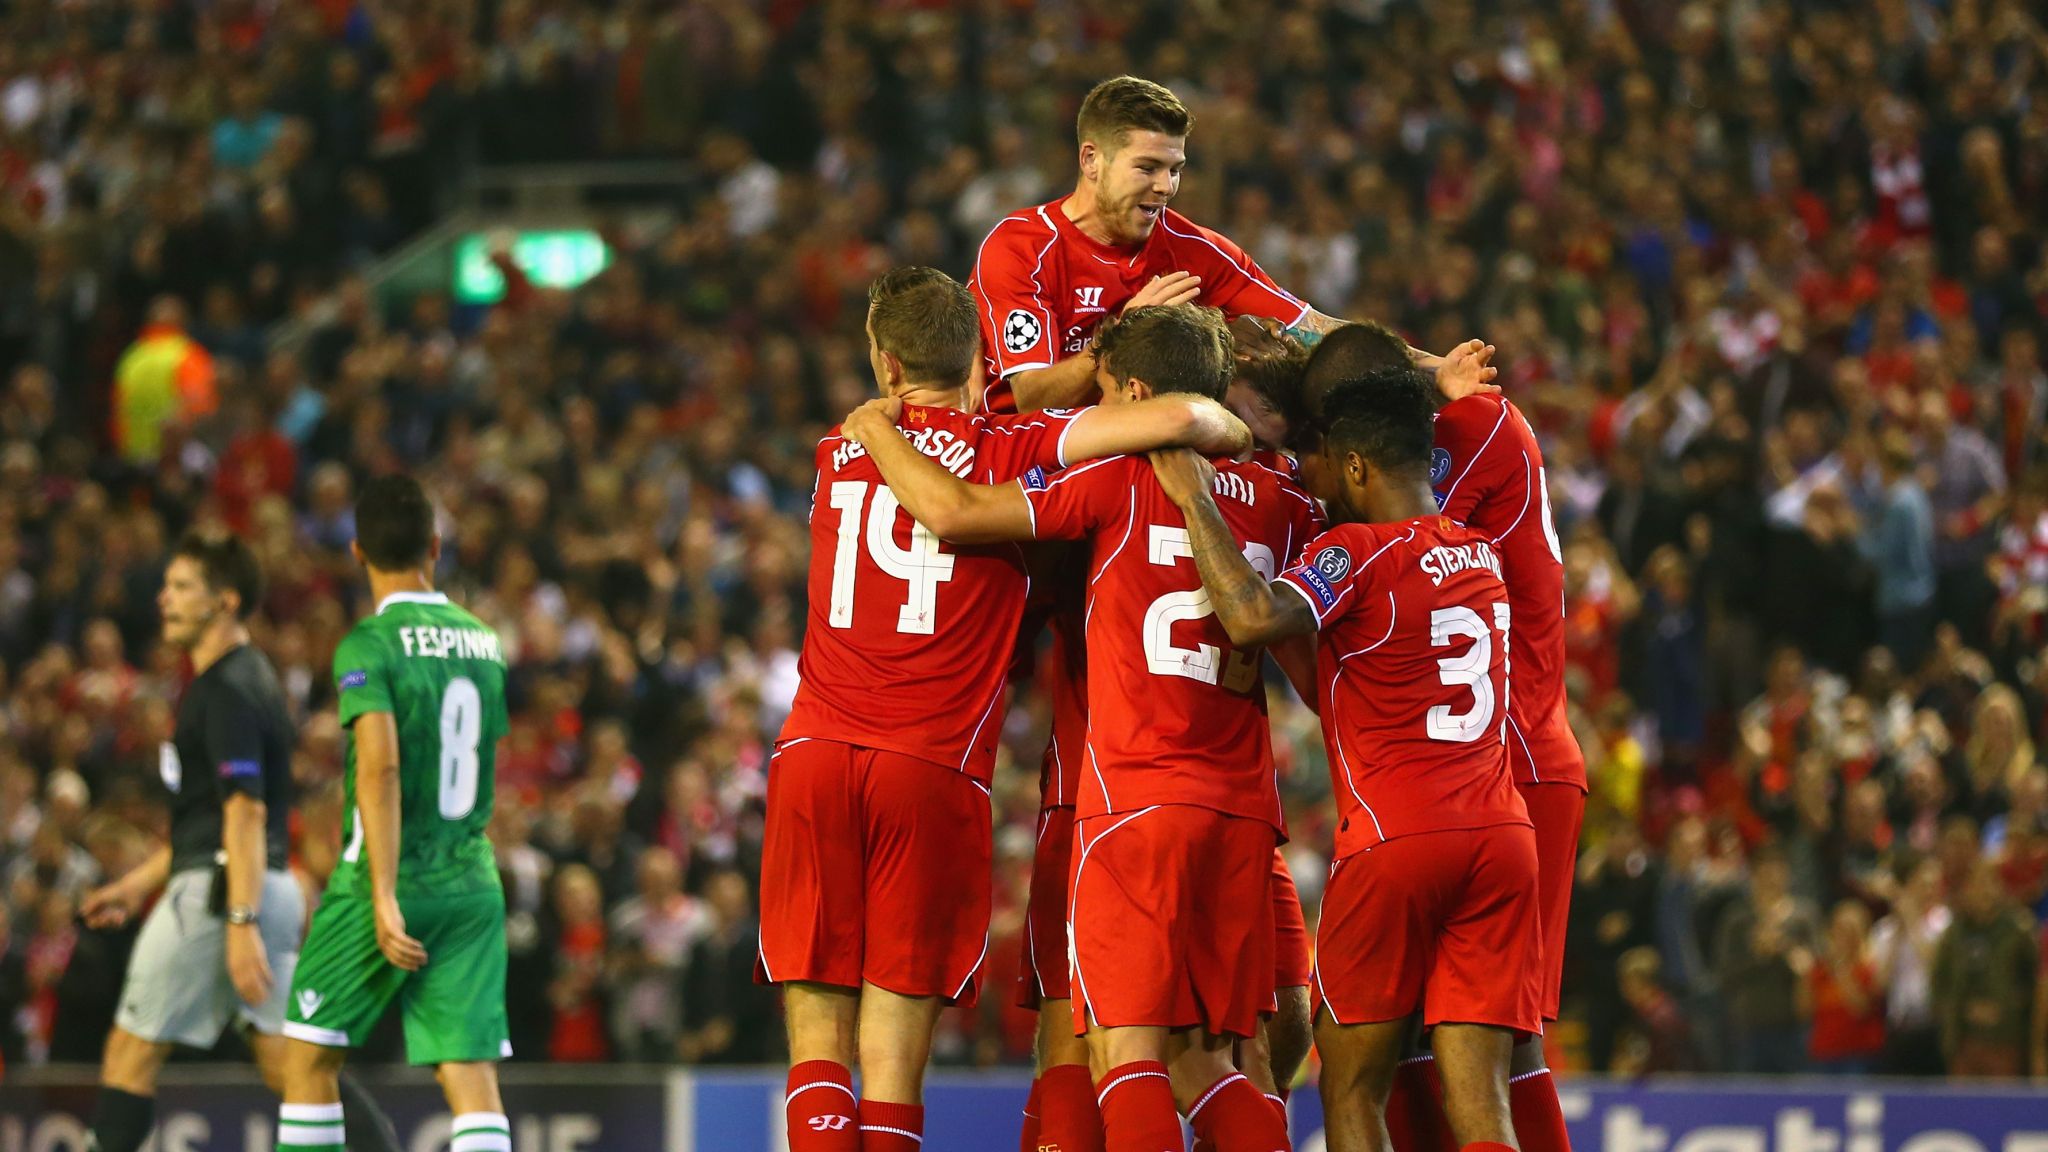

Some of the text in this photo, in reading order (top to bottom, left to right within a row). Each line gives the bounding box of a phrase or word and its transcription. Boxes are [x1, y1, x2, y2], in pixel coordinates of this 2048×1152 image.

[829, 481, 956, 634] 14
[1304, 569, 1333, 605] RESPECT
[1323, 563, 1335, 574] 5
[438, 675, 482, 820] 8
